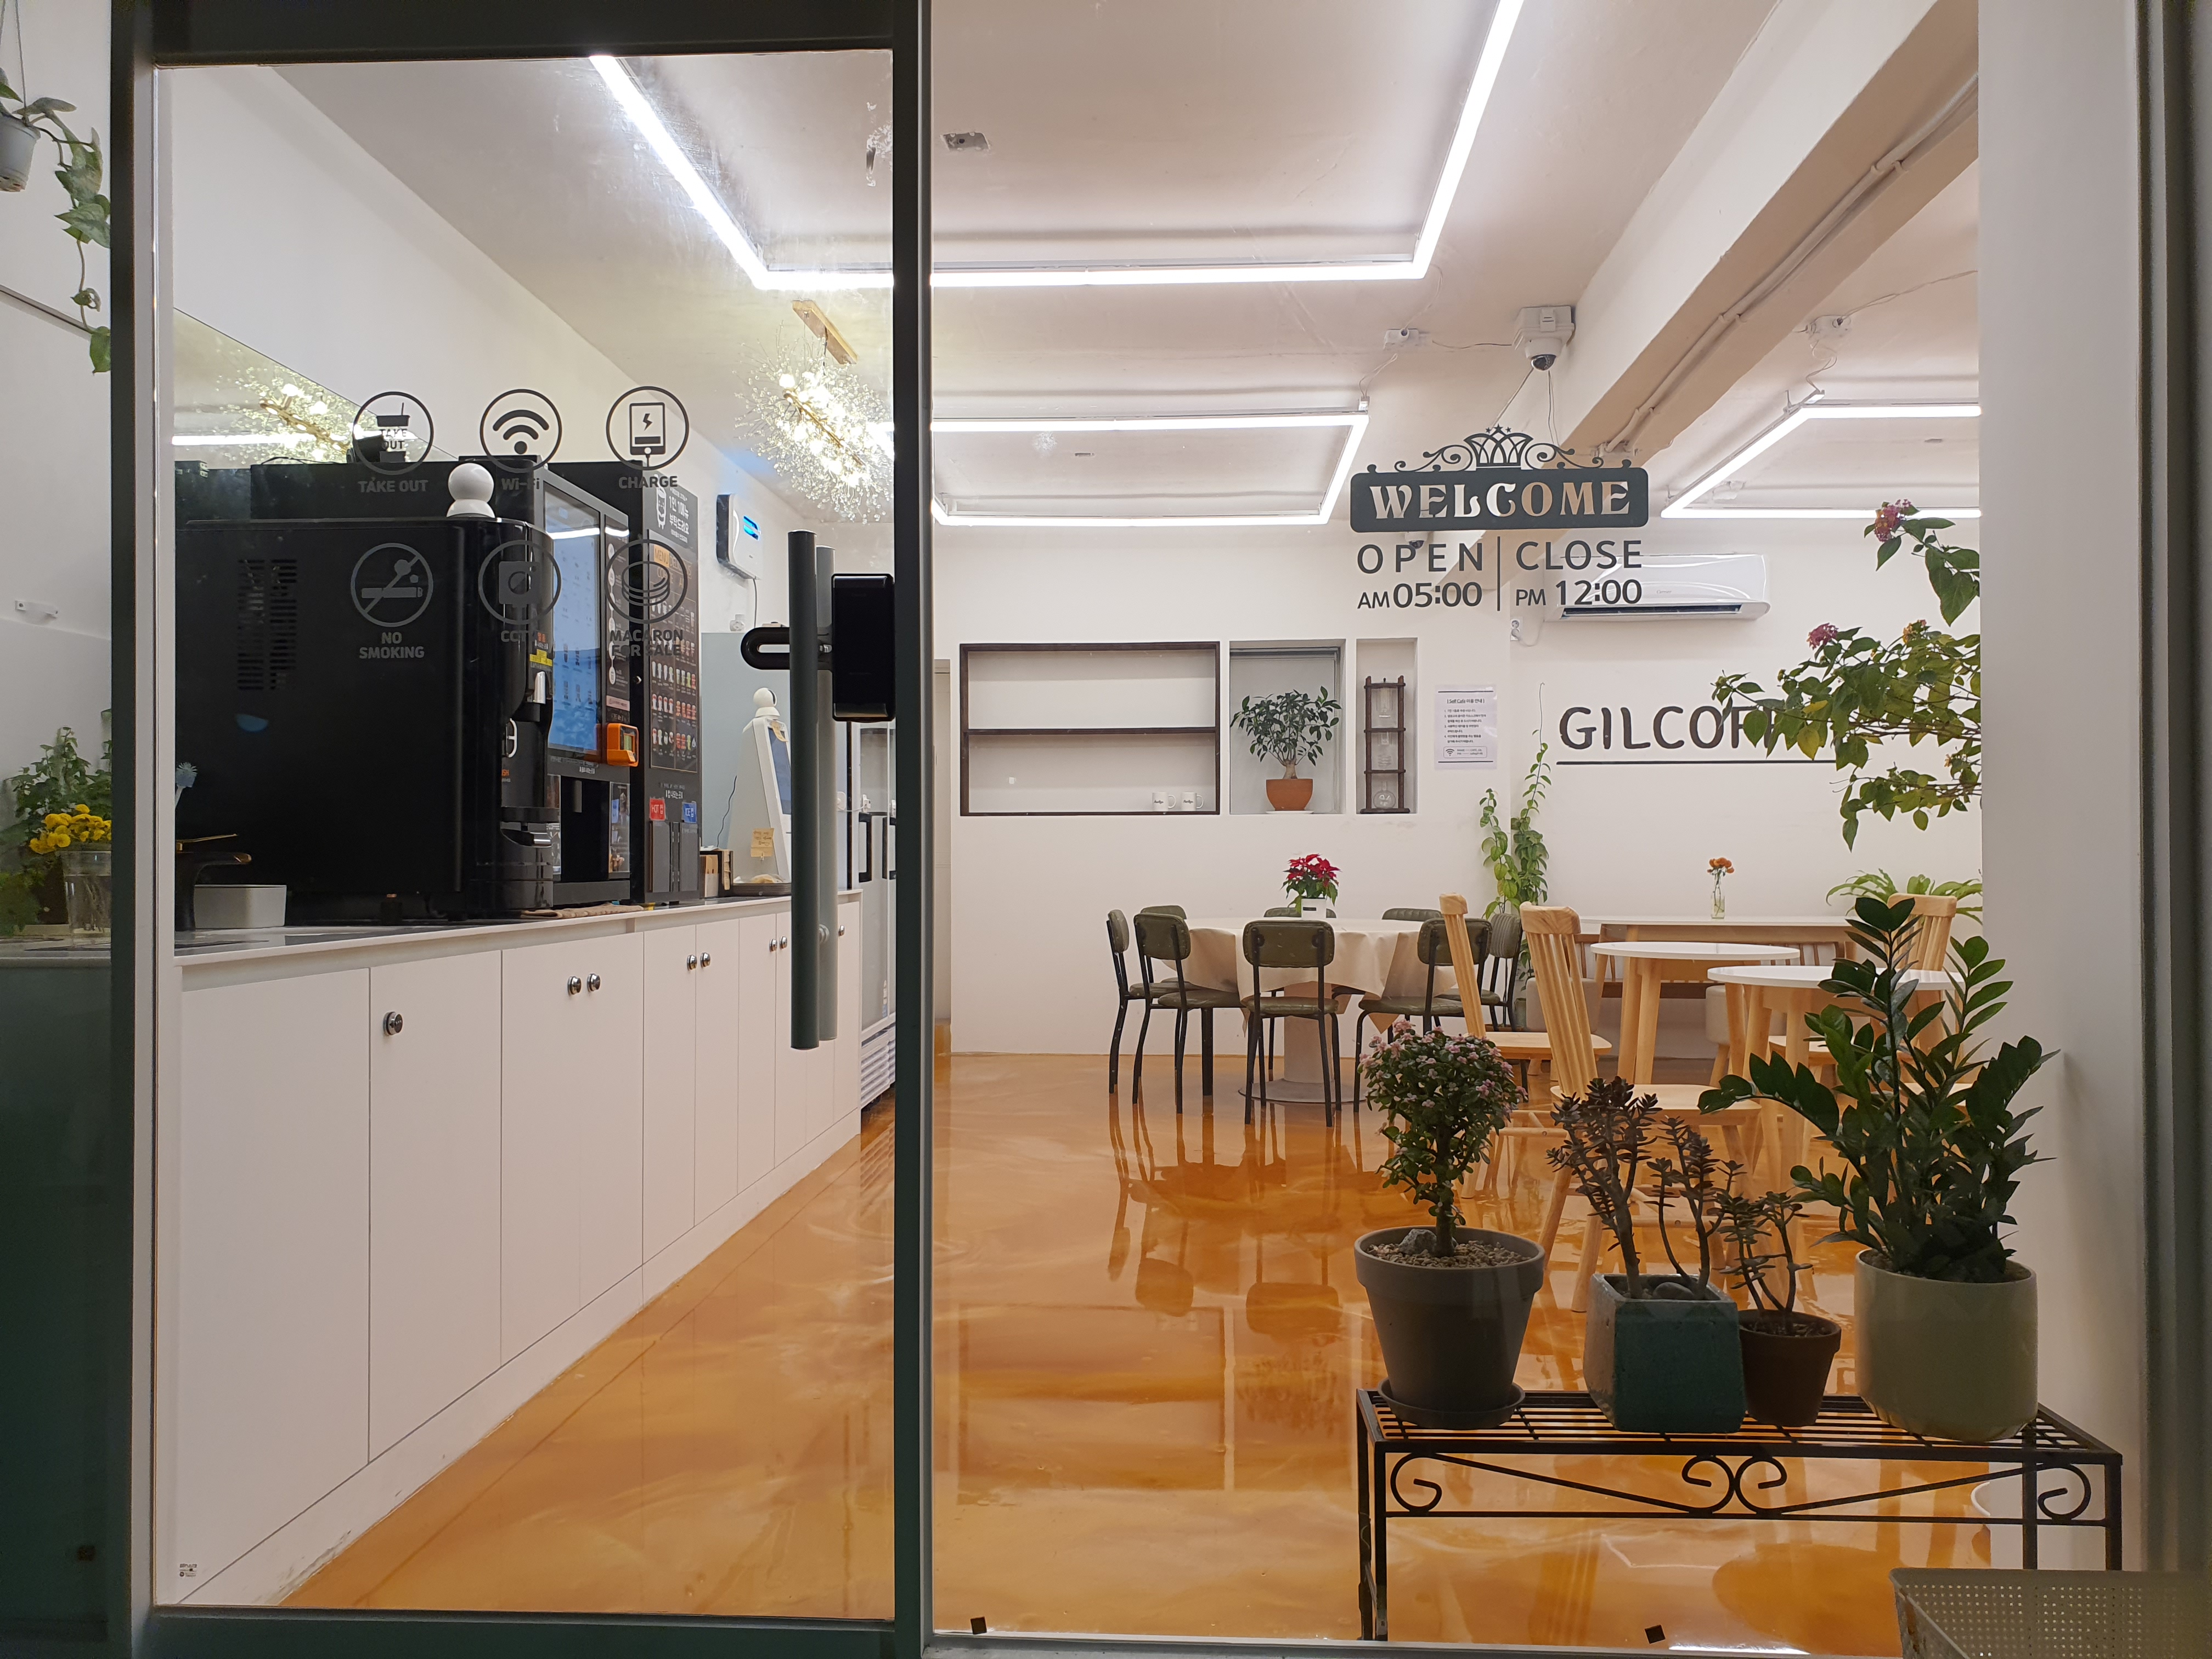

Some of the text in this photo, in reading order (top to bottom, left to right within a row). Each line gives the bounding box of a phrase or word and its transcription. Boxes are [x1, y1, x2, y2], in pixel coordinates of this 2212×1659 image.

[382, 440, 405, 449] OUT
[358, 479, 428, 493] TAKE OUT
[501, 477, 540, 490] Wi-Fi
[618, 476, 678, 489] CHARGE
[1369, 481, 1630, 520] WELCOME
[669, 514, 689, 534] 부탁드려요
[655, 549, 669, 565] MENU
[1357, 539, 1643, 574] OPEN CLOSE
[1358, 579, 1643, 609] AM 05:00 PM 12:00
[381, 631, 402, 644] NO
[501, 630, 535, 642] CCT
[610, 629, 684, 641] MACARON
[359, 646, 425, 659] SMOKING
[612, 644, 682, 657] FOR SALE
